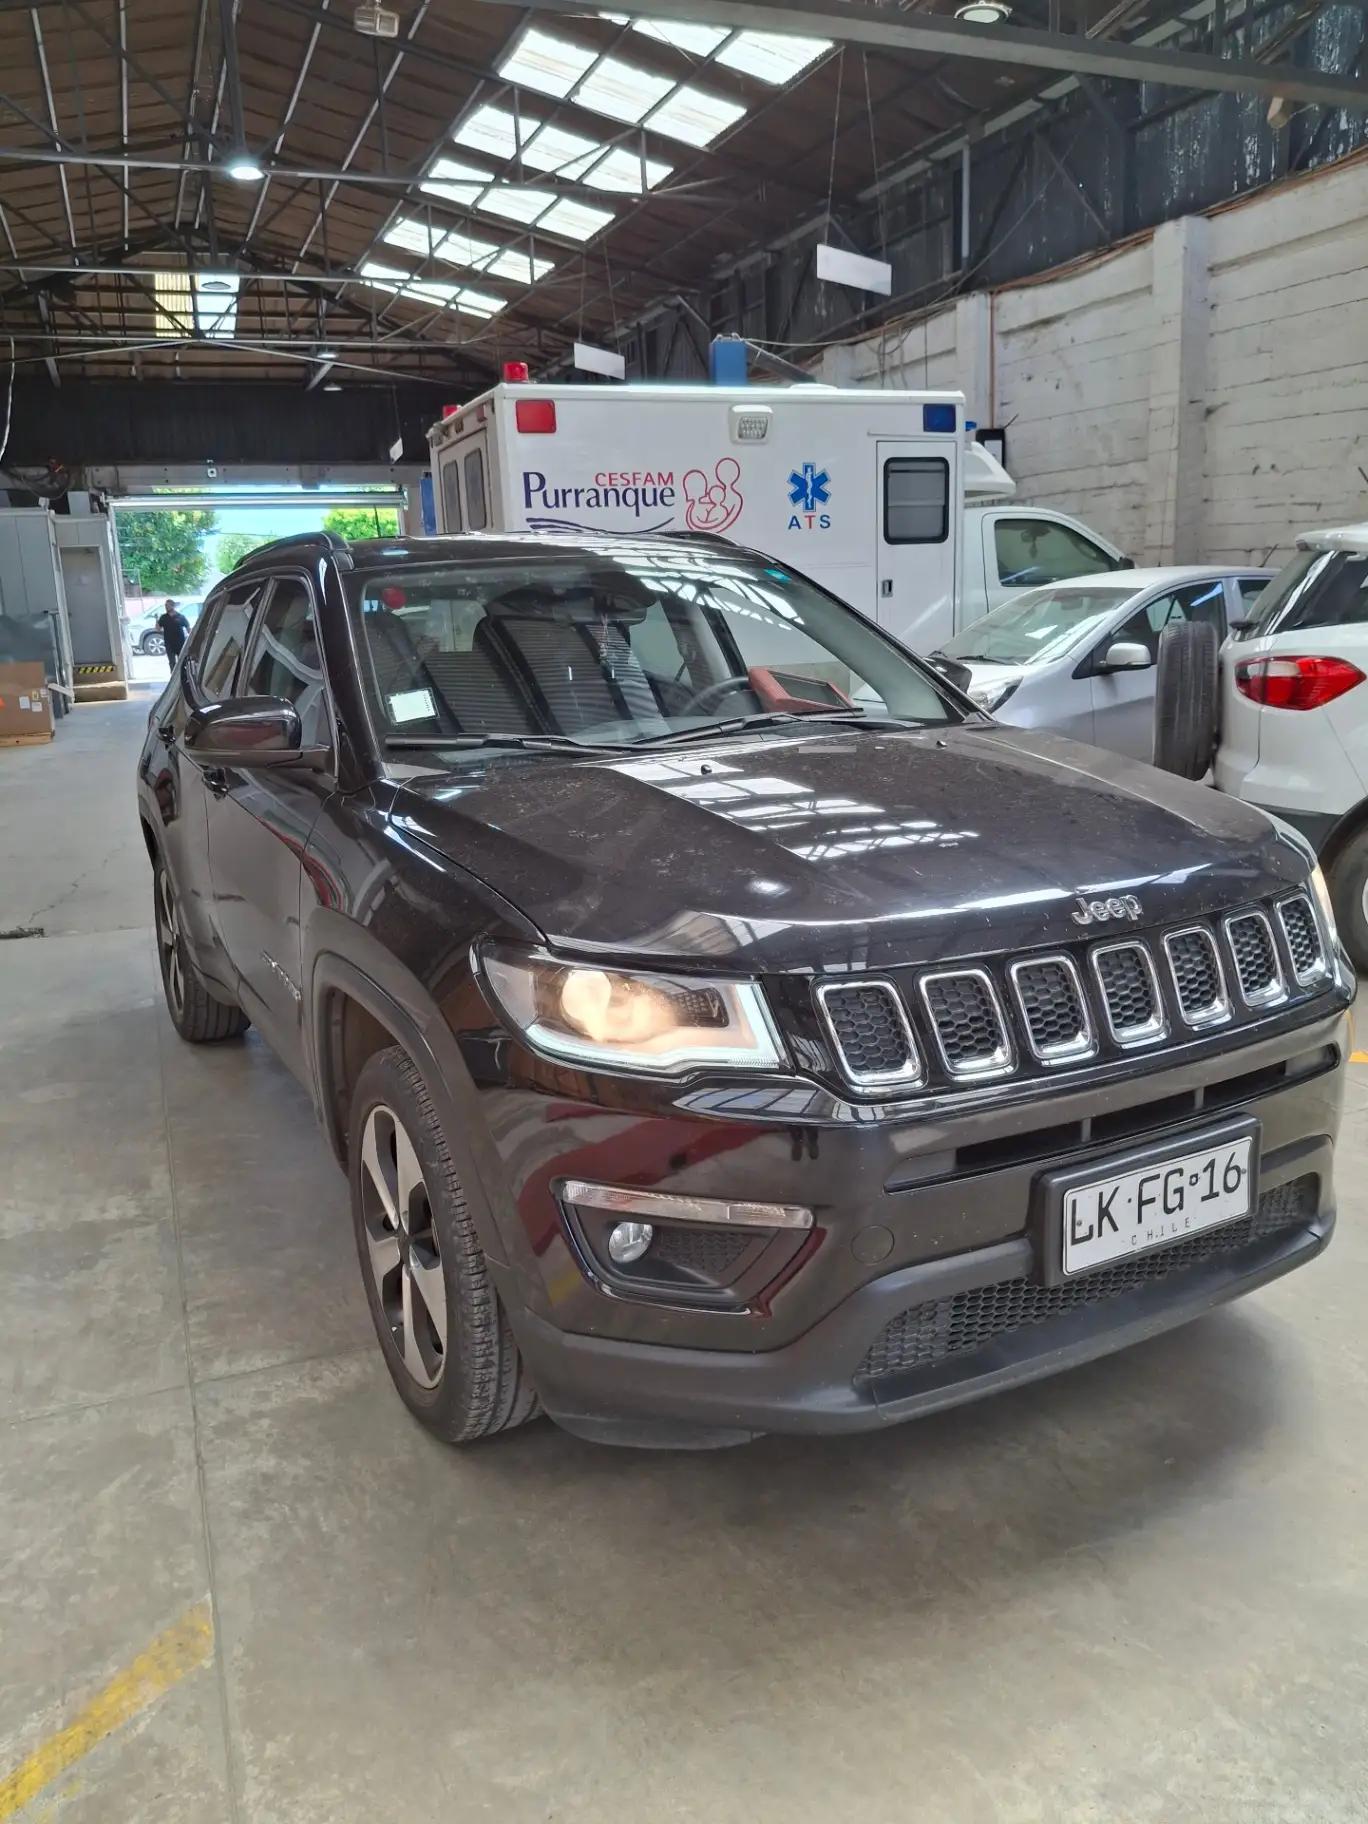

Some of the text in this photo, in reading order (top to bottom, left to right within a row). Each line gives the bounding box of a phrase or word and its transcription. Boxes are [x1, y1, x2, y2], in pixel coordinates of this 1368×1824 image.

[523, 472, 675, 517] Purranque
[595, 472, 674, 487] CESFAM
[1072, 894, 1143, 925] Jeep
[1131, 1217, 1192, 1246] CHILE
